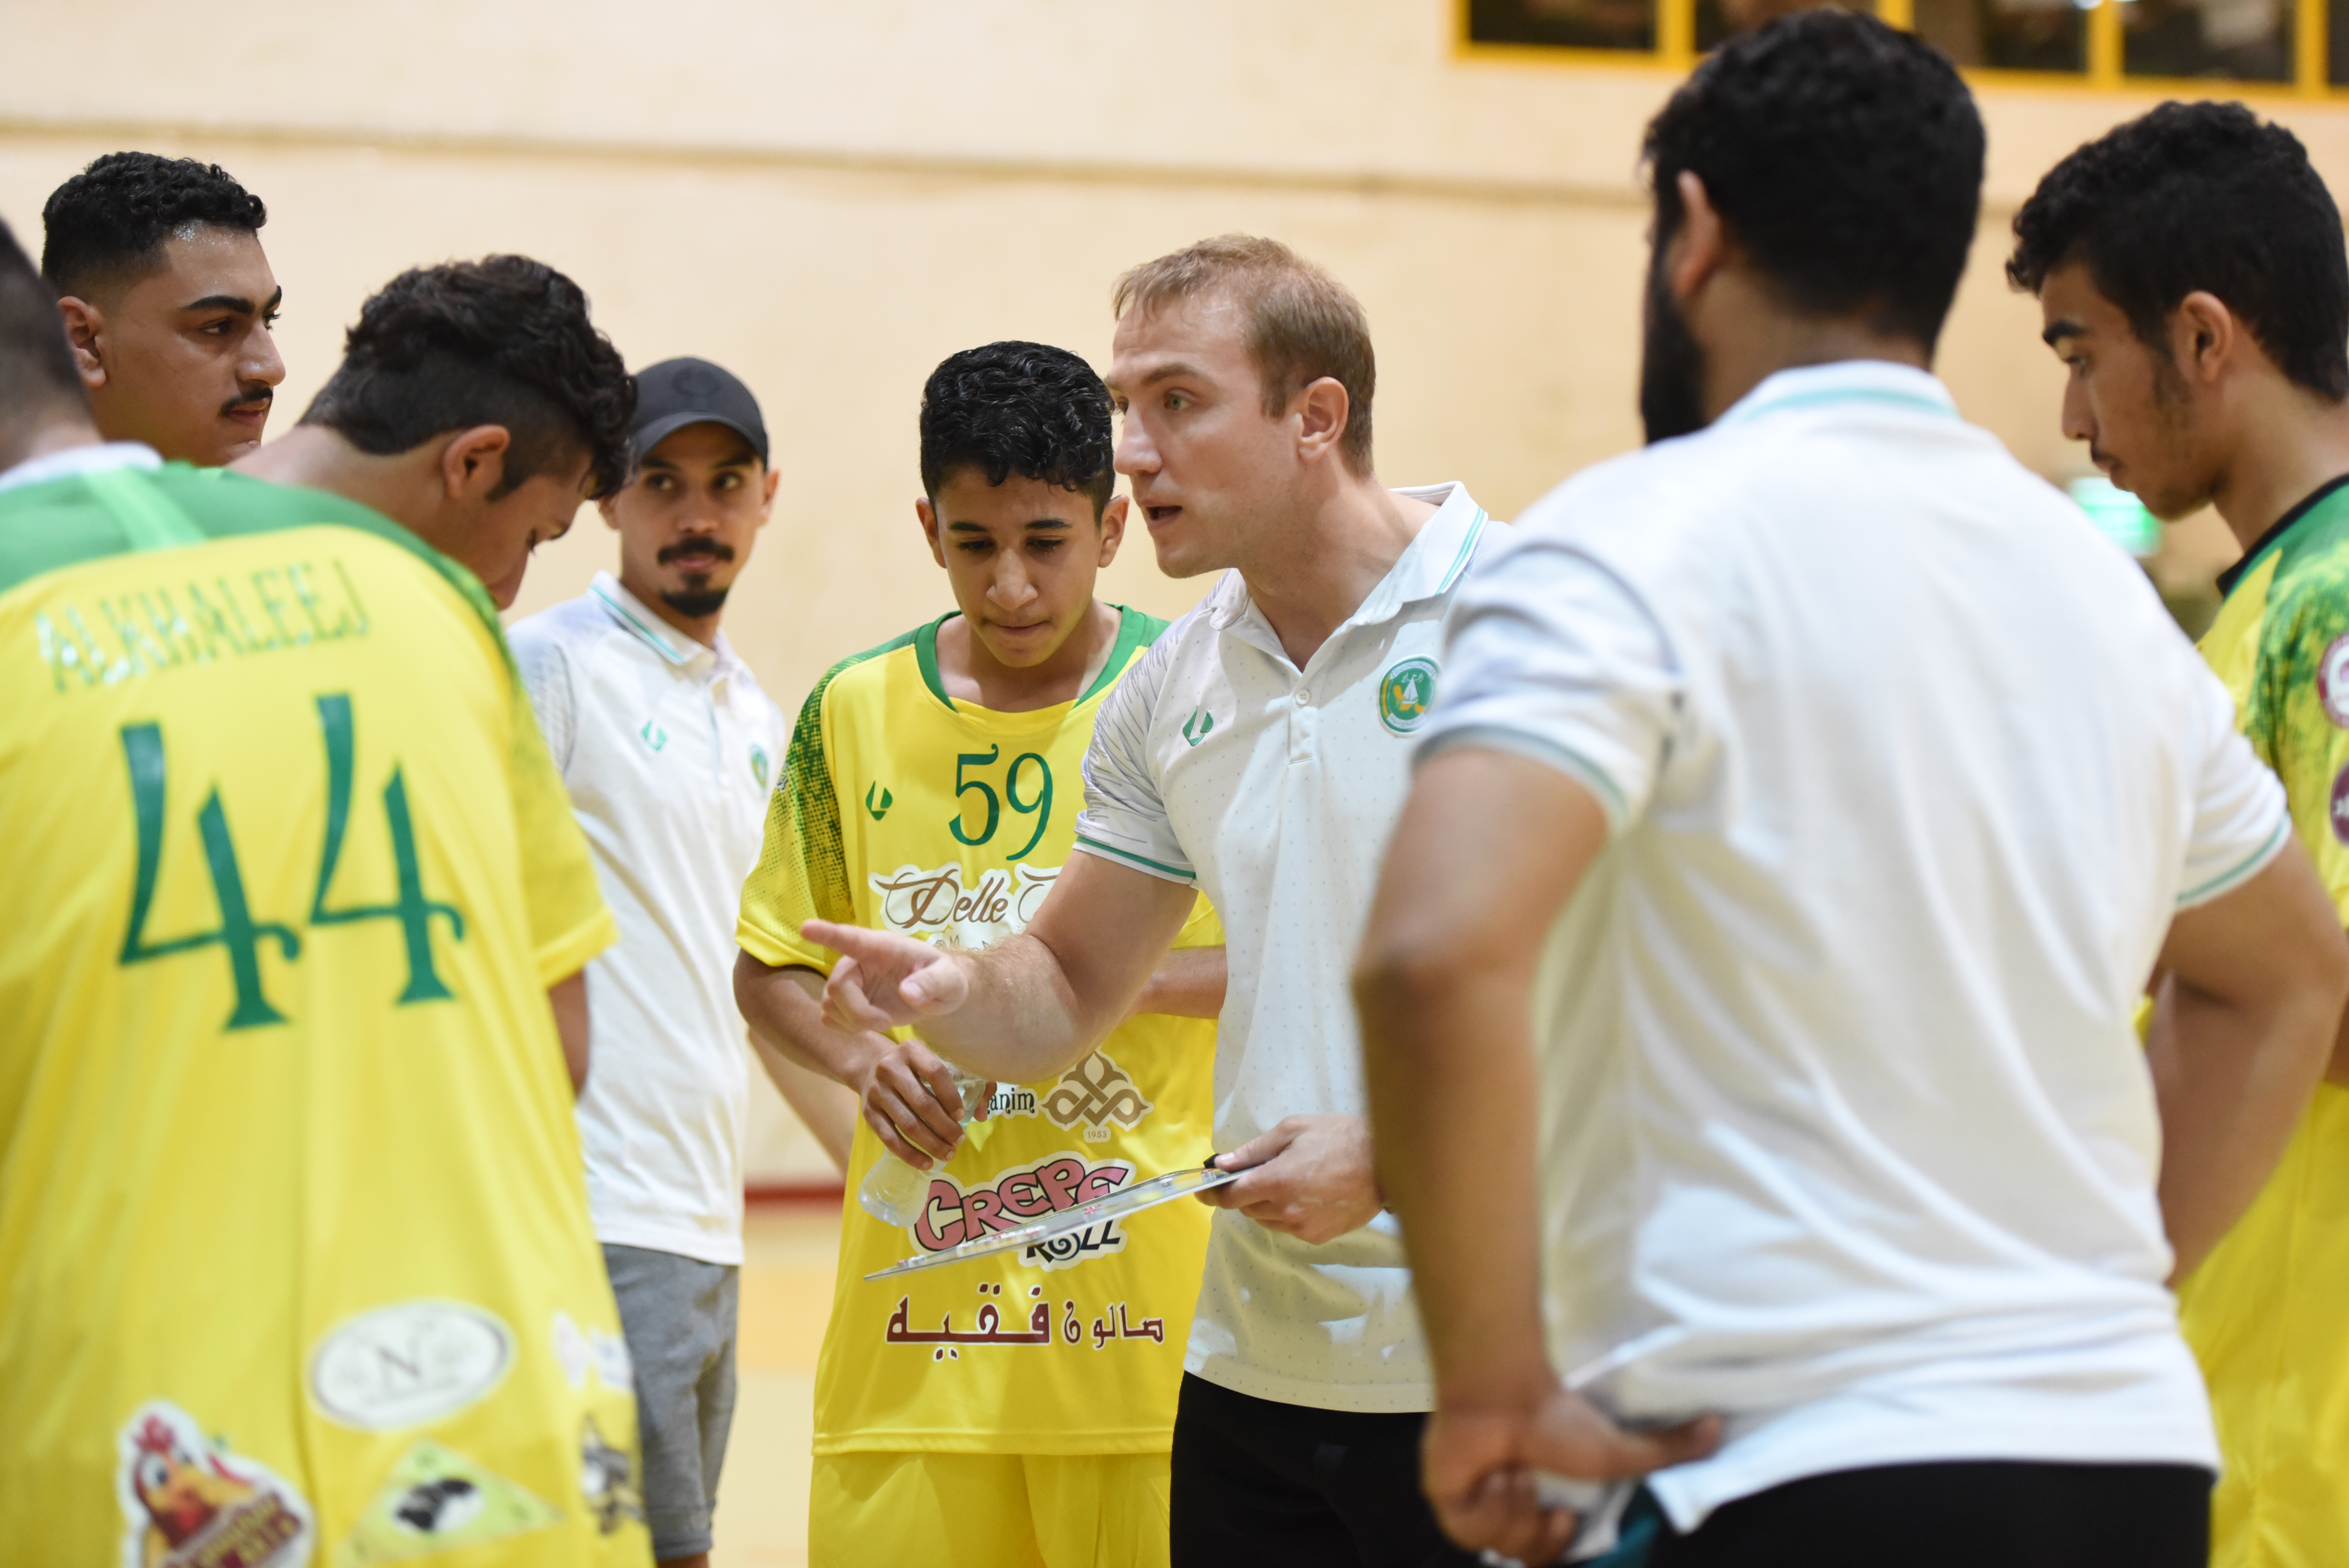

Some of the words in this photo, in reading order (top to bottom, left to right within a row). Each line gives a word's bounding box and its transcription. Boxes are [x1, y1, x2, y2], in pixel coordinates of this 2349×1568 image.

[34, 558, 369, 693] ALKHALEEJ
[948, 743, 1053, 861] 59
[118, 691, 465, 1035] 44
[874, 868, 1009, 929] Delle
[987, 1087, 1035, 1114] anim
[887, 1283, 1050, 1361] فقيه
[1063, 1301, 1164, 1348] صالون
